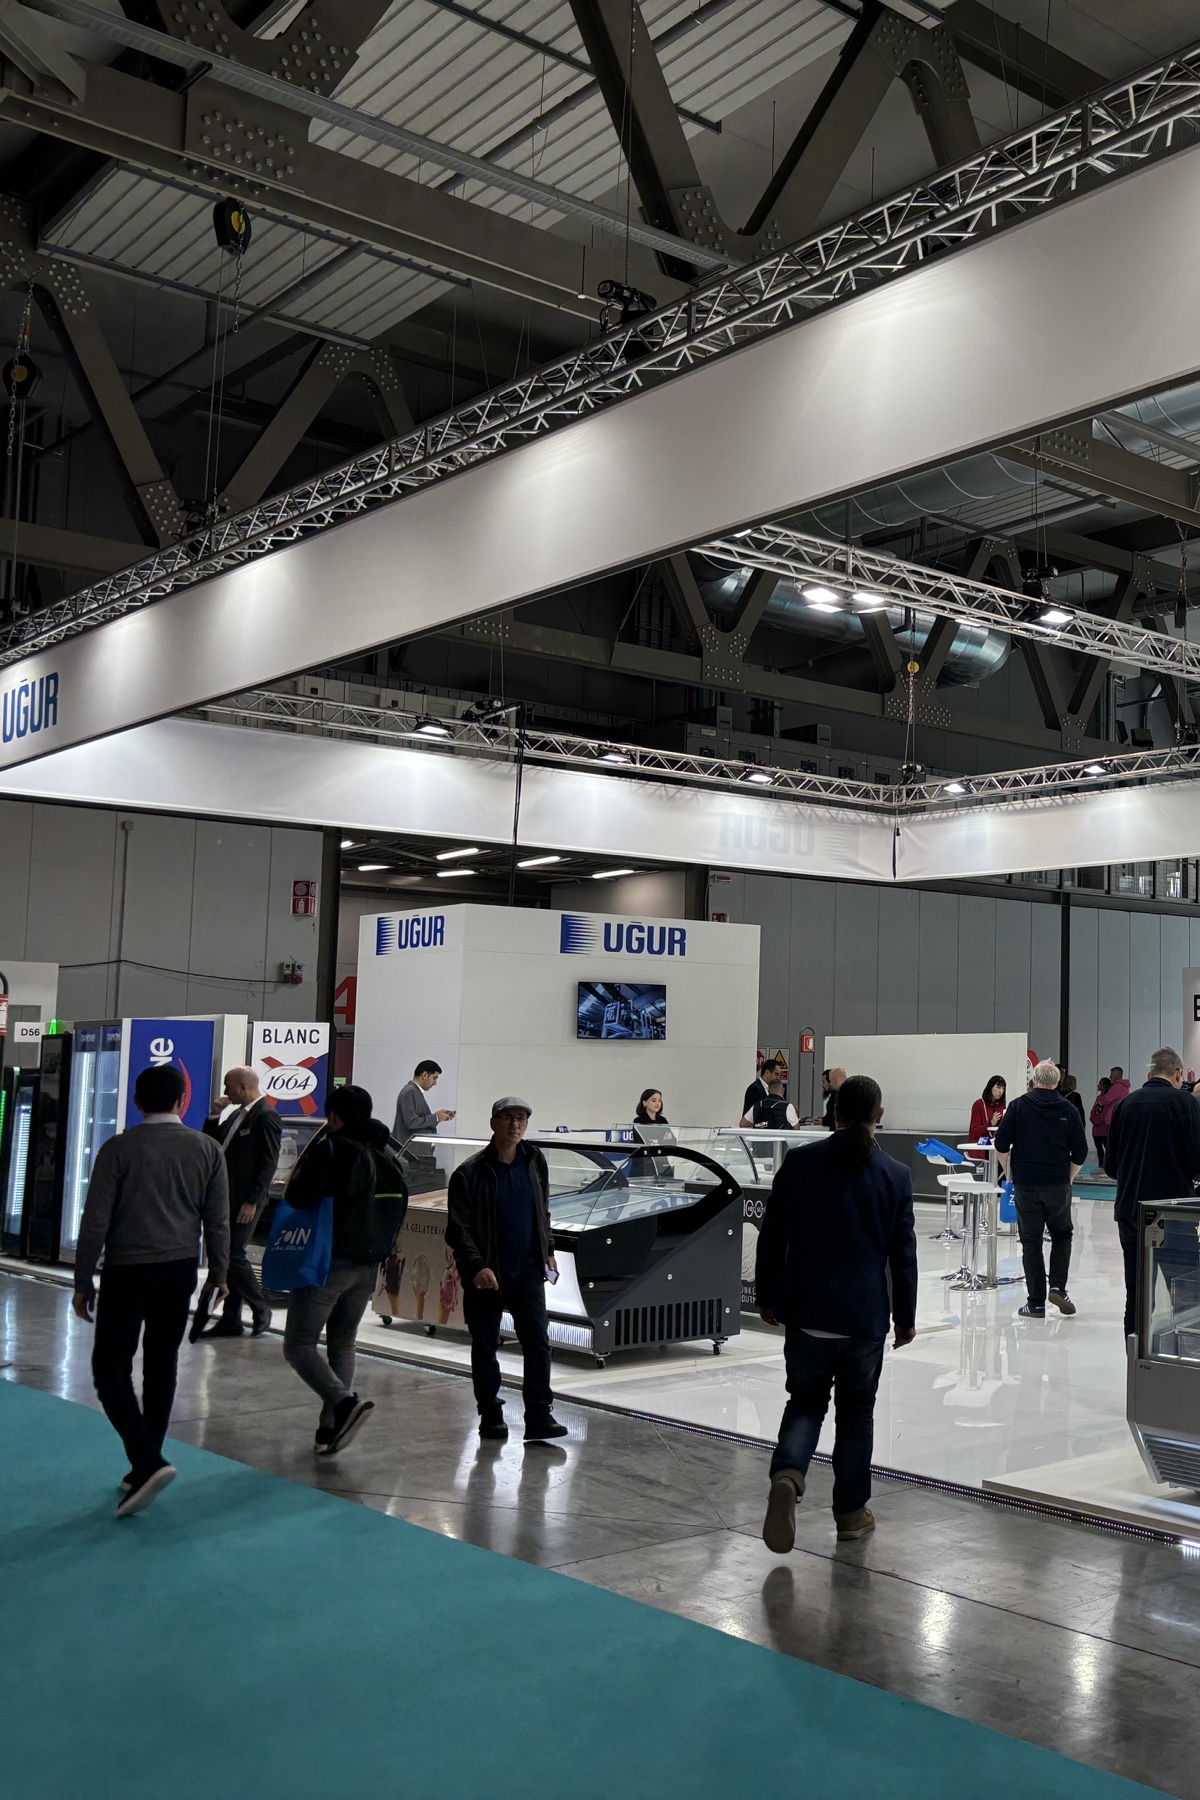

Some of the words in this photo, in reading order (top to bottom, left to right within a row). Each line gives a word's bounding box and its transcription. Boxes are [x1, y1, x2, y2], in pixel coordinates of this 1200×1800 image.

[20, 1028, 41, 1037] D56
[262, 1028, 321, 1045] BLANC
[266, 1071, 315, 1092] 1664
